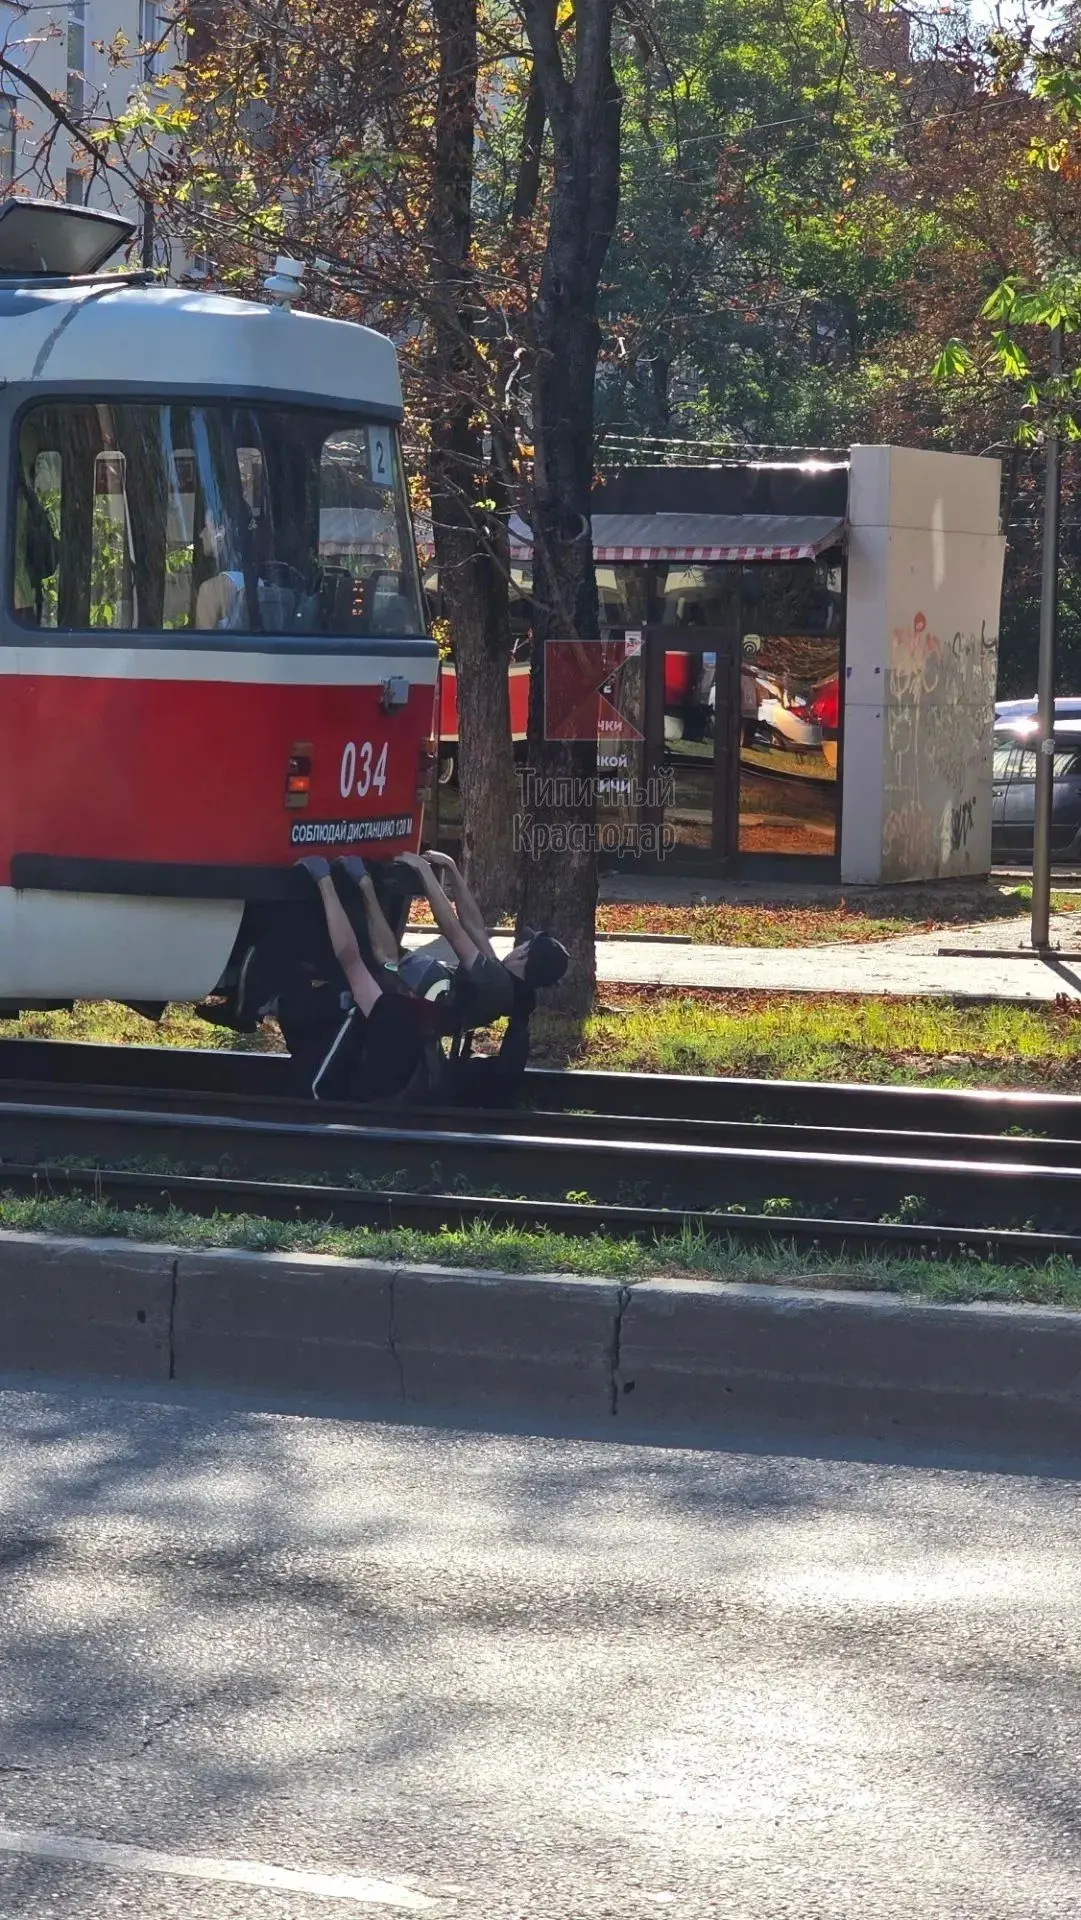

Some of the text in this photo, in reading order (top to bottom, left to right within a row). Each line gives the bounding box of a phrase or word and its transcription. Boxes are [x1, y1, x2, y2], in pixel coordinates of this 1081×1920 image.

[375, 440, 386, 474] 2
[340, 741, 389, 798] 034
[291, 820, 348, 844] СОБЛЮДАЙ
[346, 820, 395, 844] ДИСТАНЦИЮ
[395, 819, 407, 836] 120
